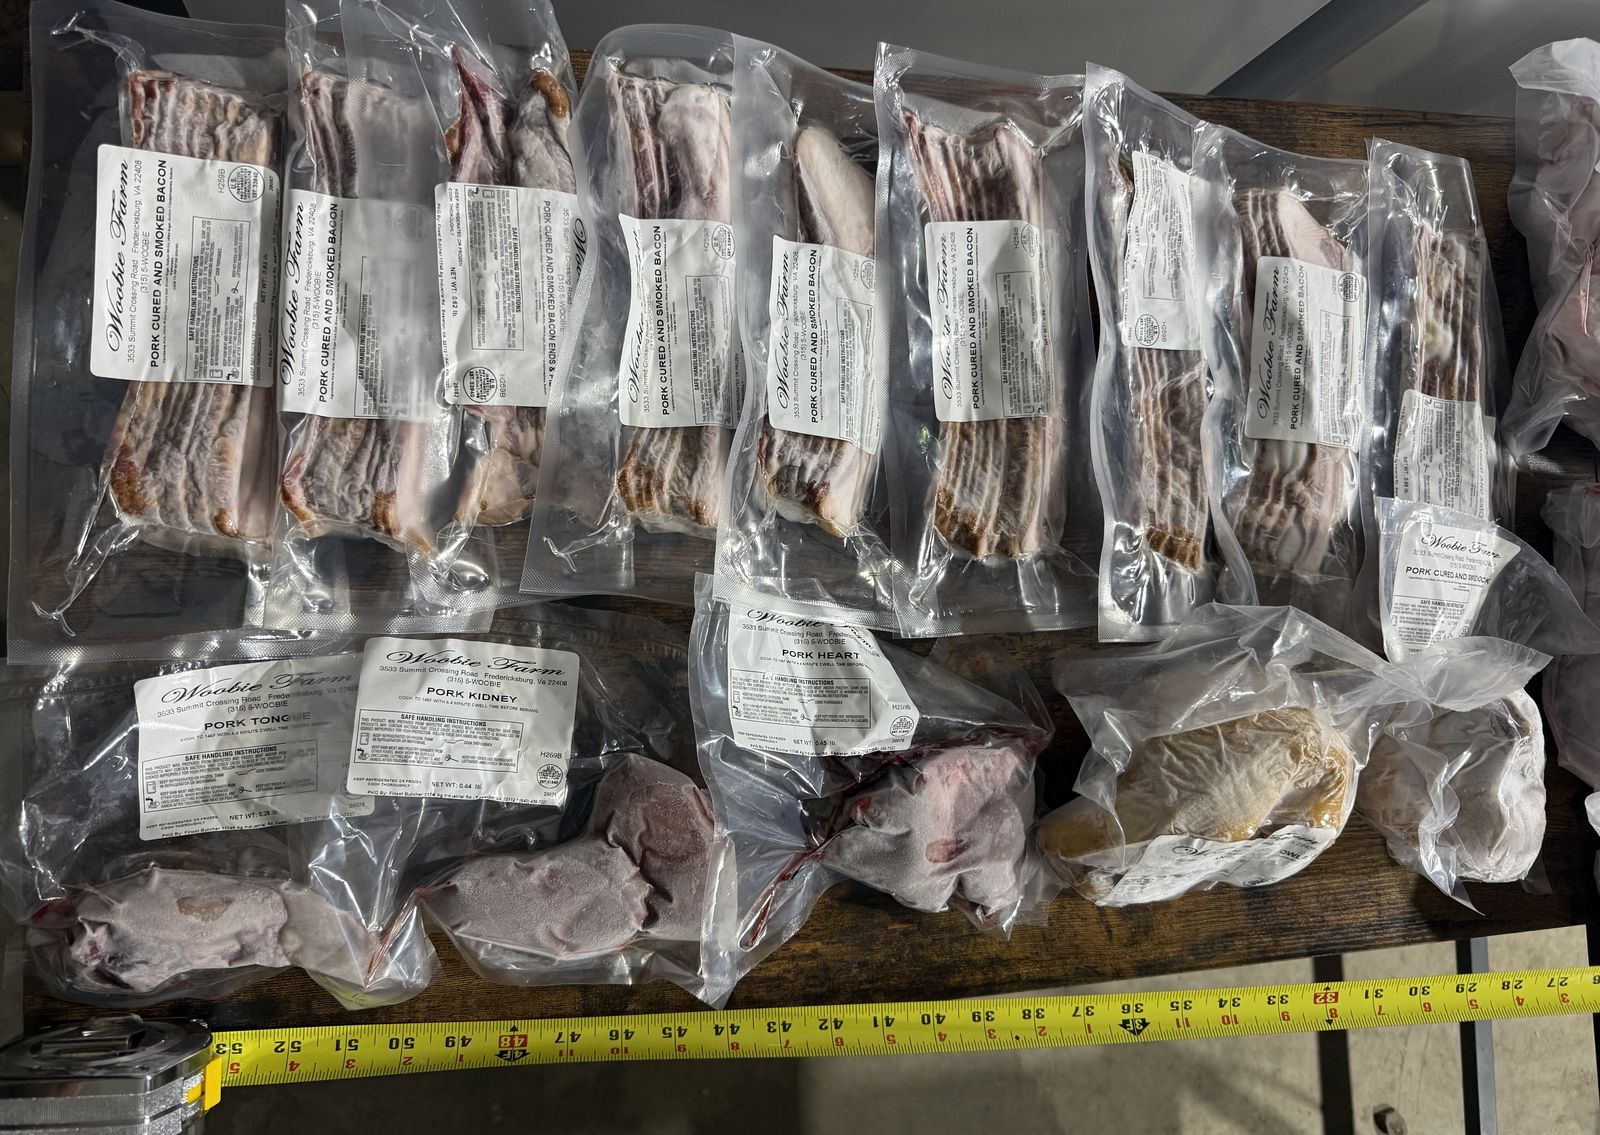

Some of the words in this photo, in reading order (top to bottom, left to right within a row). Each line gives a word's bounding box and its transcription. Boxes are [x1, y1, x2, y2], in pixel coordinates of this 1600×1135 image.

[134, 160, 142, 183] 22408
[156, 160, 166, 202] BACON
[134, 185, 142, 196] VA
[109, 159, 129, 246] Farm
[543, 201, 551, 223] PORK
[328, 203, 338, 244] BACON
[155, 206, 165, 257] SMOKED
[285, 201, 305, 284] Farm
[653, 226, 661, 265] BACON
[154, 261, 163, 286] AND
[326, 247, 336, 296] SMOKED
[808, 249, 817, 286] BACON
[937, 234, 949, 309] Farm
[191, 256, 199, 295] INSTRUCTIONS
[776, 251, 790, 321] Farm
[967, 268, 975, 313] SMOKED
[130, 281, 139, 312] Crossing
[546, 275, 554, 310] SMOKED
[655, 269, 663, 316] SMOKED
[106, 252, 126, 351] Woobie
[1263, 266, 1280, 336] Farm
[152, 289, 161, 330] CURED
[189, 297, 197, 325] HANDLING
[324, 299, 333, 323] AND
[809, 289, 817, 329] SMOKED
[1297, 300, 1305, 341] SMOKED
[657, 319, 665, 342] AND
[280, 289, 300, 385] Woobie
[150, 334, 160, 367] PORK
[321, 327, 330, 366] CURED
[627, 313, 645, 403] Woobie
[1294, 344, 1303, 365] AND
[659, 346, 667, 383] CURED
[775, 327, 790, 409] Woobie
[810, 357, 818, 392] CURED
[1257, 341, 1275, 419] Woobie
[319, 370, 328, 402] PORK
[1292, 367, 1301, 400] CURED
[661, 386, 670, 415] PORK
[972, 380, 980, 409] PORK
[1290, 404, 1300, 429] PORK
[1421, 534, 1466, 552] Woobie
[1406, 566, 1430, 576] PORK
[747, 609, 825, 627] Woobie
[782, 649, 813, 659] PORK
[818, 651, 859, 659] HEART
[386, 649, 481, 667] Woobie
[488, 656, 565, 676] Farm
[379, 665, 397, 673] 3533
[429, 667, 459, 676] Crossing
[447, 676, 463, 684] (315)
[161, 678, 263, 704] Woobie
[269, 671, 351, 689] Farm
[427, 687, 464, 698] PORK
[469, 692, 517, 703] KIDNEY
[204, 719, 246, 730] PORK
[1456, 982, 1477, 993] 29
[1502, 980, 1523, 990] 28
[1547, 976, 1568, 987] 27
[1365, 988, 1383, 999] 31
[1409, 986, 1430, 996] 30
[1218, 997, 1240, 1008] 34
[1267, 994, 1288, 1005] 33
[1315, 993, 1336, 1003] 32
[1469, 999, 1479, 1009] 5
[1515, 996, 1525, 1006] 4
[1561, 993, 1569, 1003] 3
[1072, 1005, 1094, 1017] 37
[1122, 1003, 1143, 1014] 36
[1170, 1000, 1192, 1011] 35
[1378, 1005, 1385, 1015] 7
[1423, 1002, 1431, 1012] 6
[921, 1013, 945, 1025] 40
[971, 1011, 994, 1022] 39
[1021, 1008, 1045, 1019] 38
[1281, 1011, 1290, 1021] 9
[1329, 1008, 1337, 1018] 8
[819, 1018, 843, 1030] 42
[872, 1016, 895, 1028] 41
[1125, 1019, 1142, 1030] 3F
[1175, 1017, 1190, 1028] 11
[1221, 1014, 1238, 1025] 10
[662, 1026, 687, 1038] 45
[713, 1023, 740, 1036] 44
[767, 1021, 791, 1033] 43
[1037, 1026, 1047, 1036] 2
[1087, 1023, 1092, 1033] 1
[554, 1032, 580, 1042] 47
[609, 1028, 634, 1040] 46
[885, 1034, 895, 1044] 5
[938, 1032, 947, 1042] 4
[987, 1028, 996, 1039] 3
[274, 1040, 301, 1053] 52
[335, 1039, 358, 1051] 51
[389, 1037, 414, 1049] 50
[445, 1036, 472, 1048] 49
[500, 1036, 524, 1046] 48
[730, 1042, 739, 1050] 8
[783, 1040, 791, 1049] 7
[835, 1037, 844, 1046] 6
[215, 1043, 242, 1054] 53
[503, 1049, 523, 1058] 4F
[610, 1046, 628, 1055] 10
[677, 1044, 686, 1052] 9
[345, 1058, 355, 1068] 3
[402, 1056, 412, 1065] 2
[459, 1054, 464, 1062] 1
[229, 1062, 240, 1073] 5
[289, 1061, 300, 1071] 4
